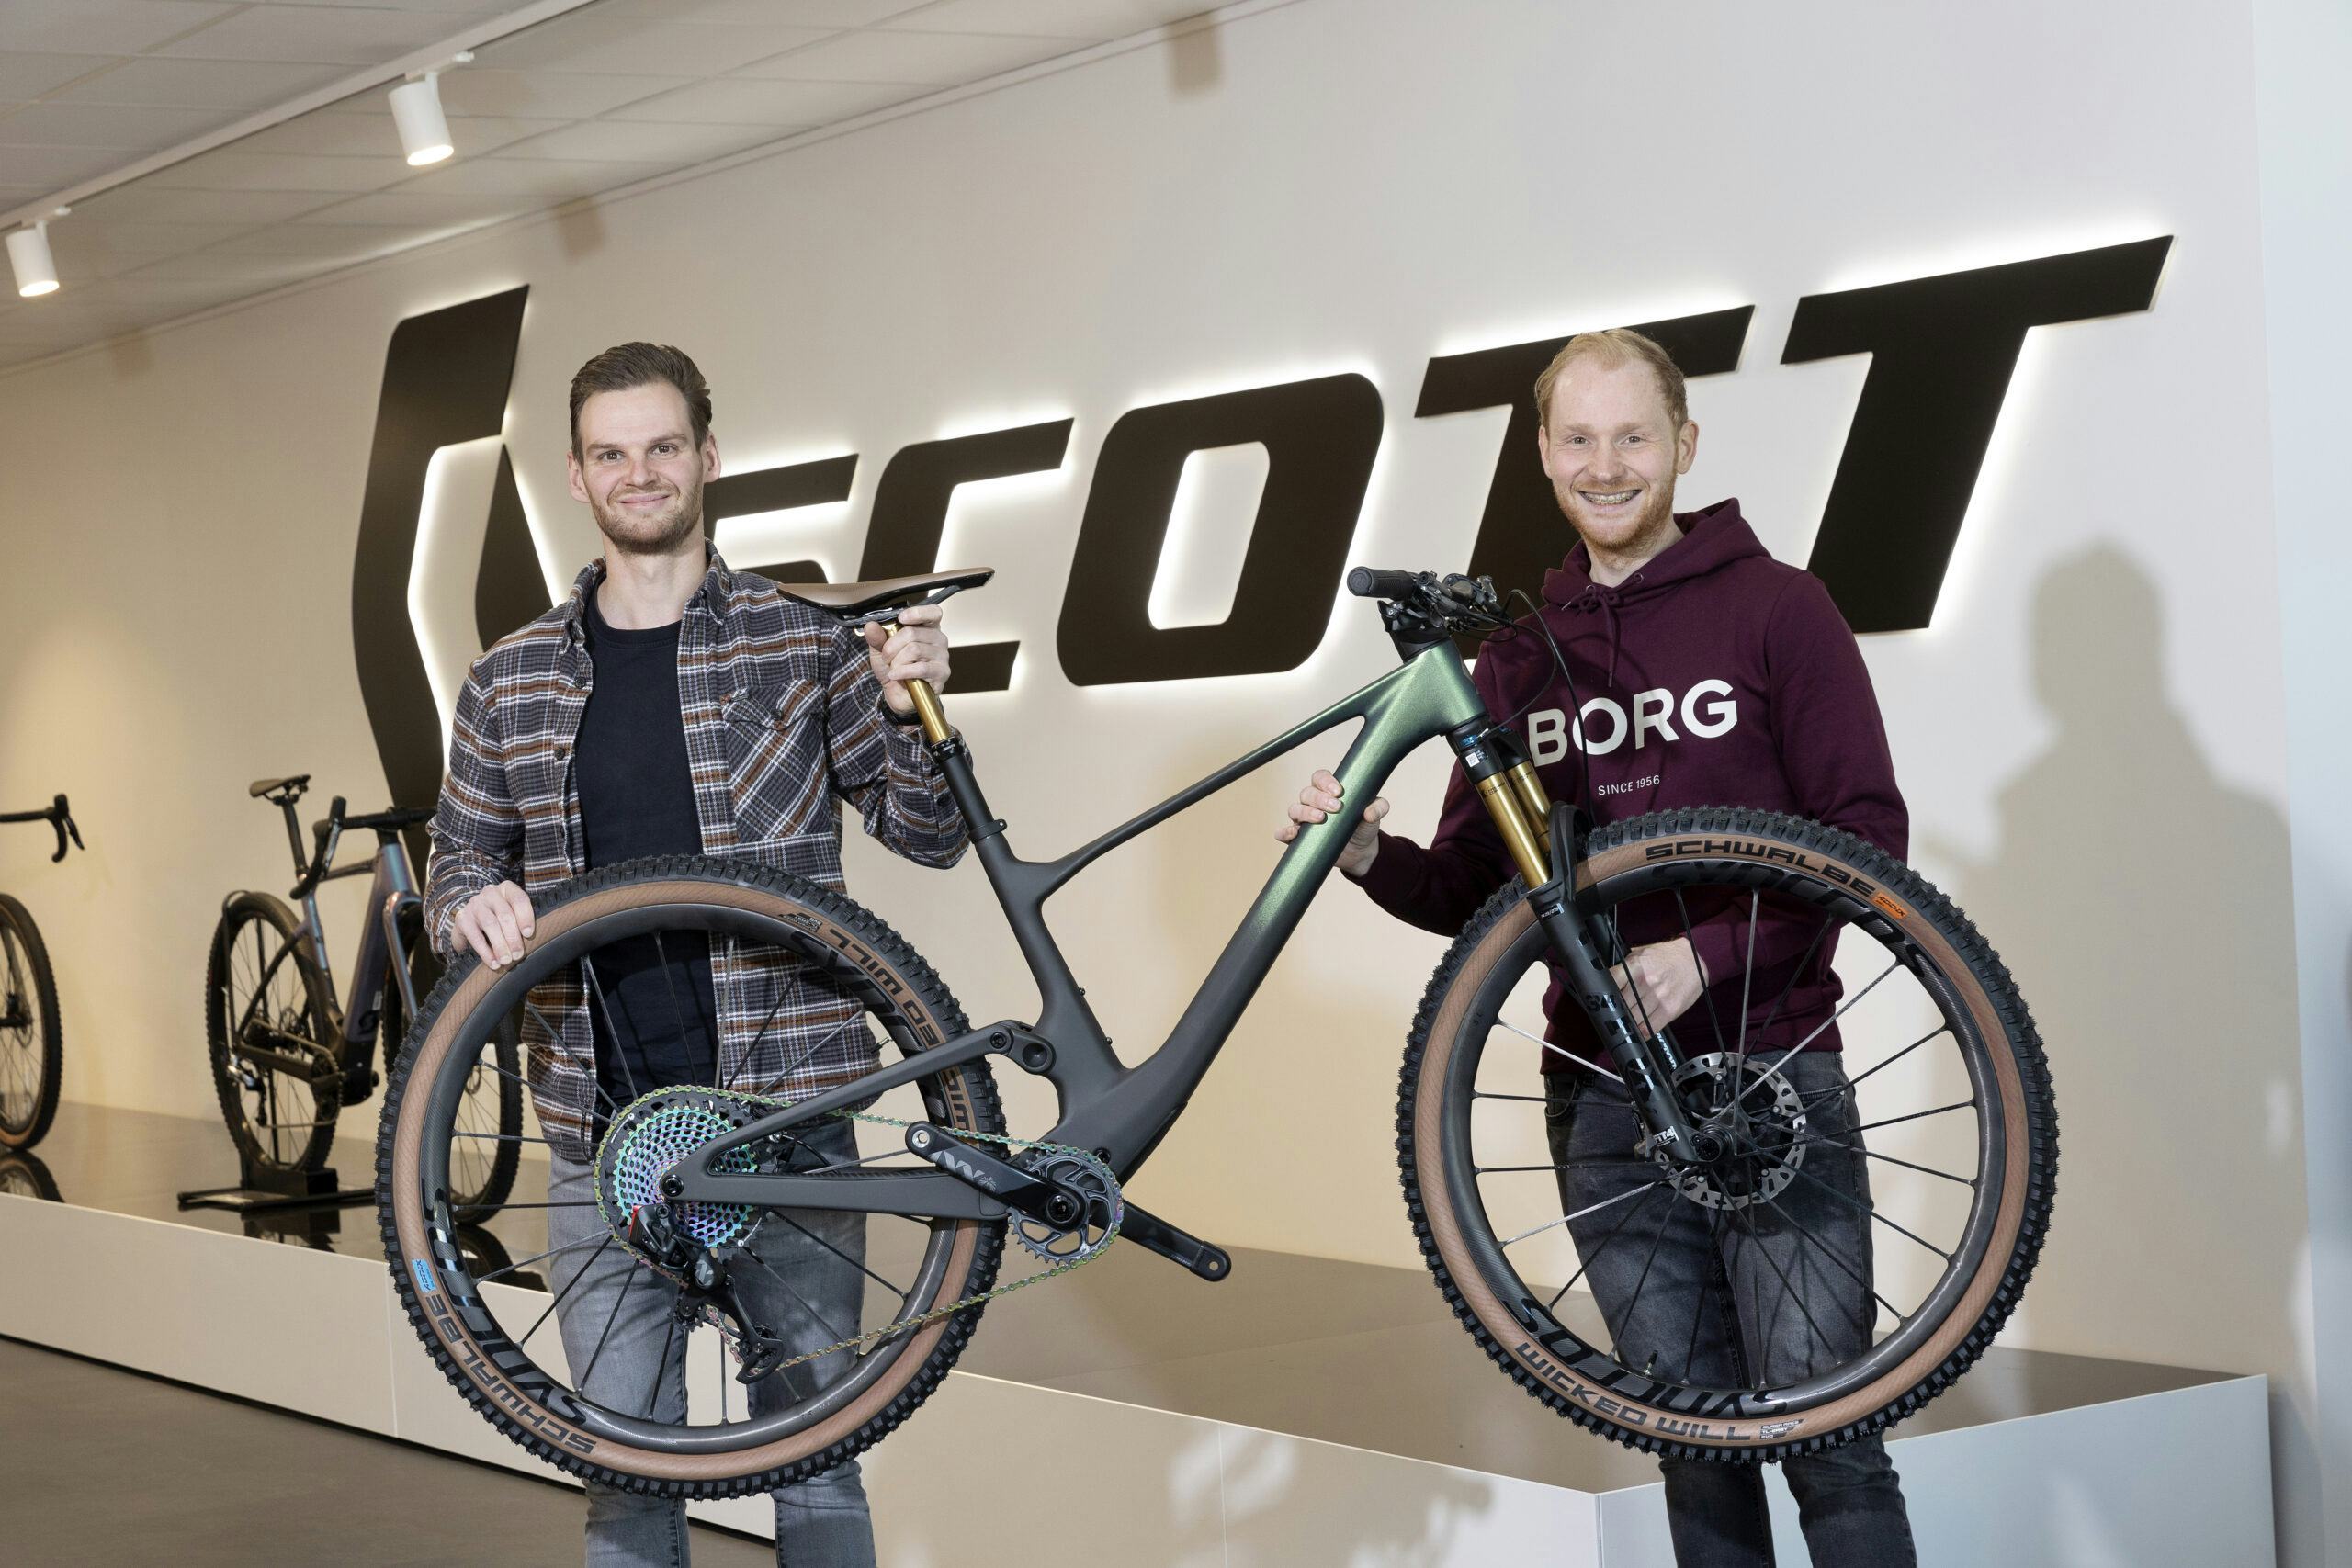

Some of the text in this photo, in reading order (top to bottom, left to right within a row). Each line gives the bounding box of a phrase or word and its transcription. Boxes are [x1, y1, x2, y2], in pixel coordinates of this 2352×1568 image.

[1527, 679, 1738, 767] BORG
[1598, 774, 1661, 795] SINCE 1956
[1645, 840, 1877, 897] SCHWALBE
[829, 928, 970, 1133] WICED WILL
[425, 1293, 597, 1454] SCHWALBE
[1516, 1342, 1750, 1440] WICKED WILL
